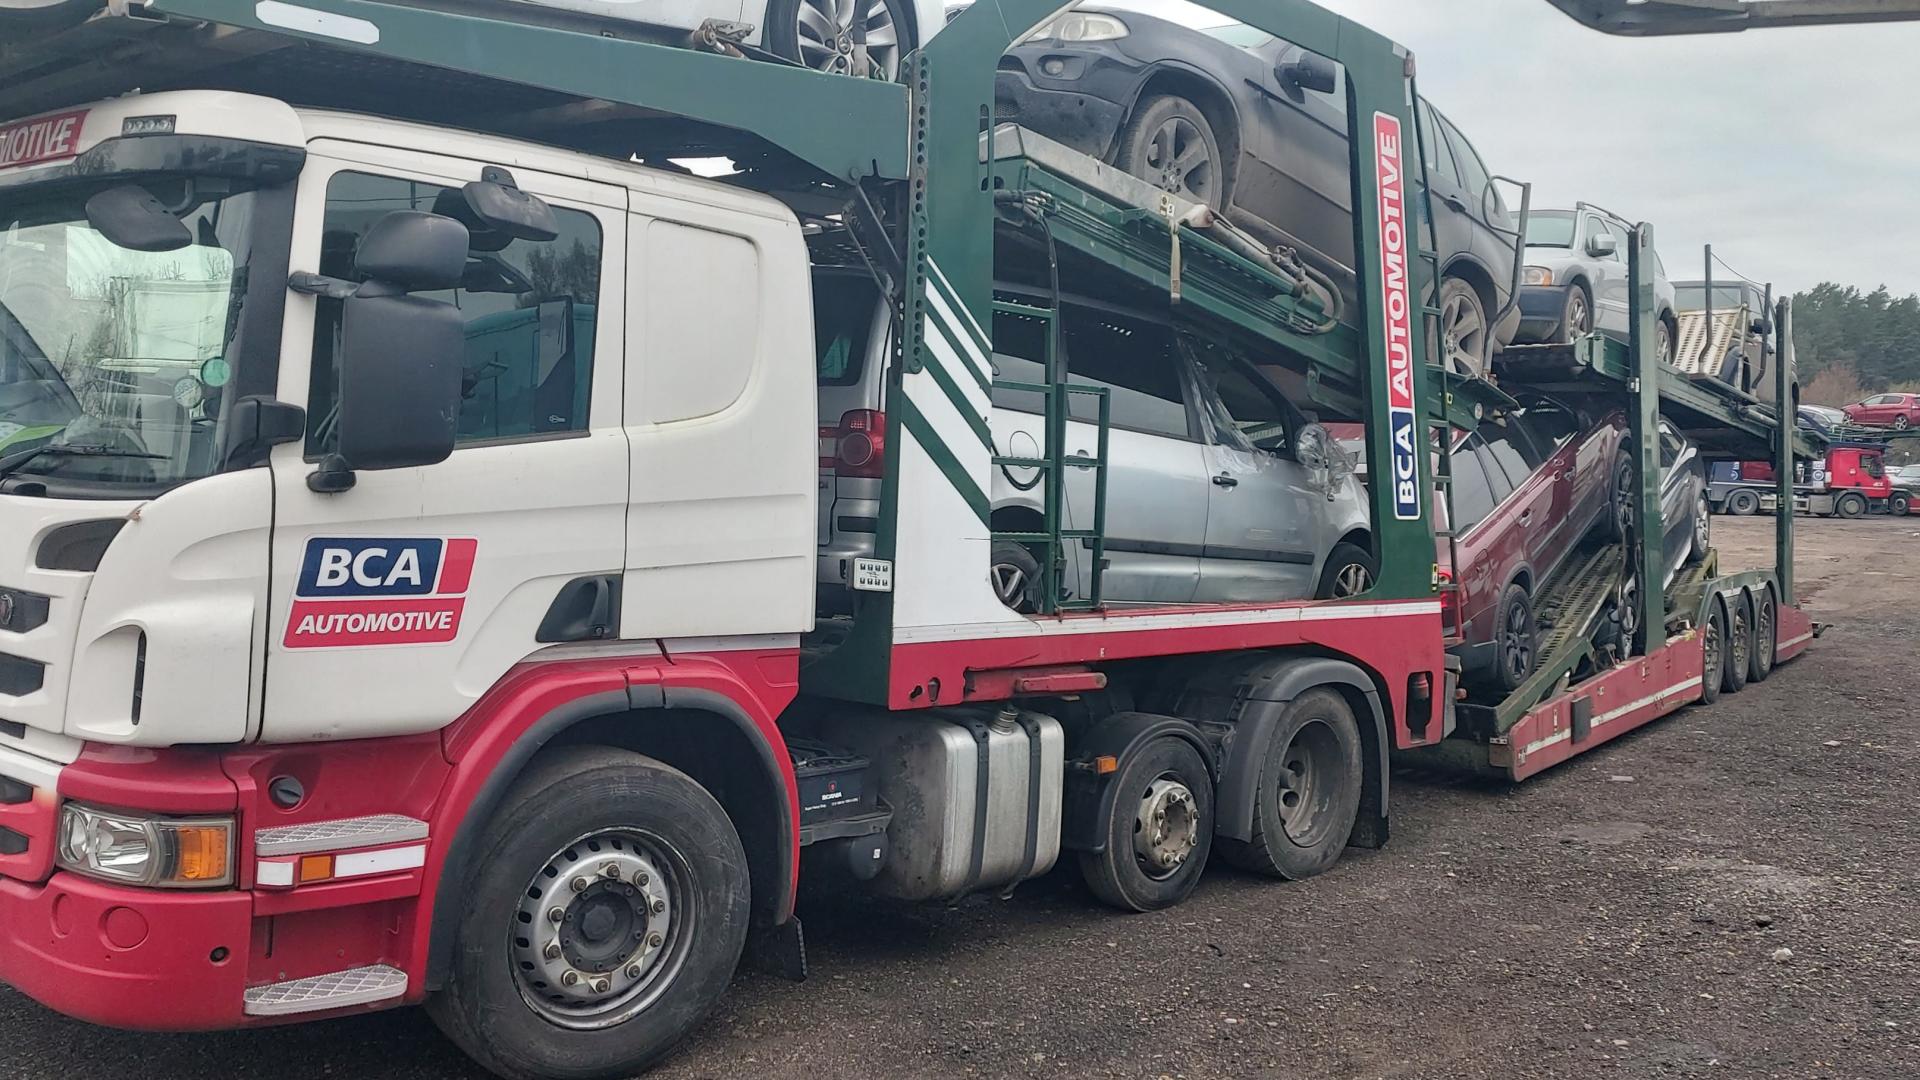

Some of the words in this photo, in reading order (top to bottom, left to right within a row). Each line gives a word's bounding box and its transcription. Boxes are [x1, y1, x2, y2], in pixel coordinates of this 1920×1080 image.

[1380, 132, 1409, 400] AUTOMOTIVE
[1395, 423, 1415, 504] BCA
[315, 548, 421, 587] BCA
[295, 611, 453, 635] AUTOMOTIVE
